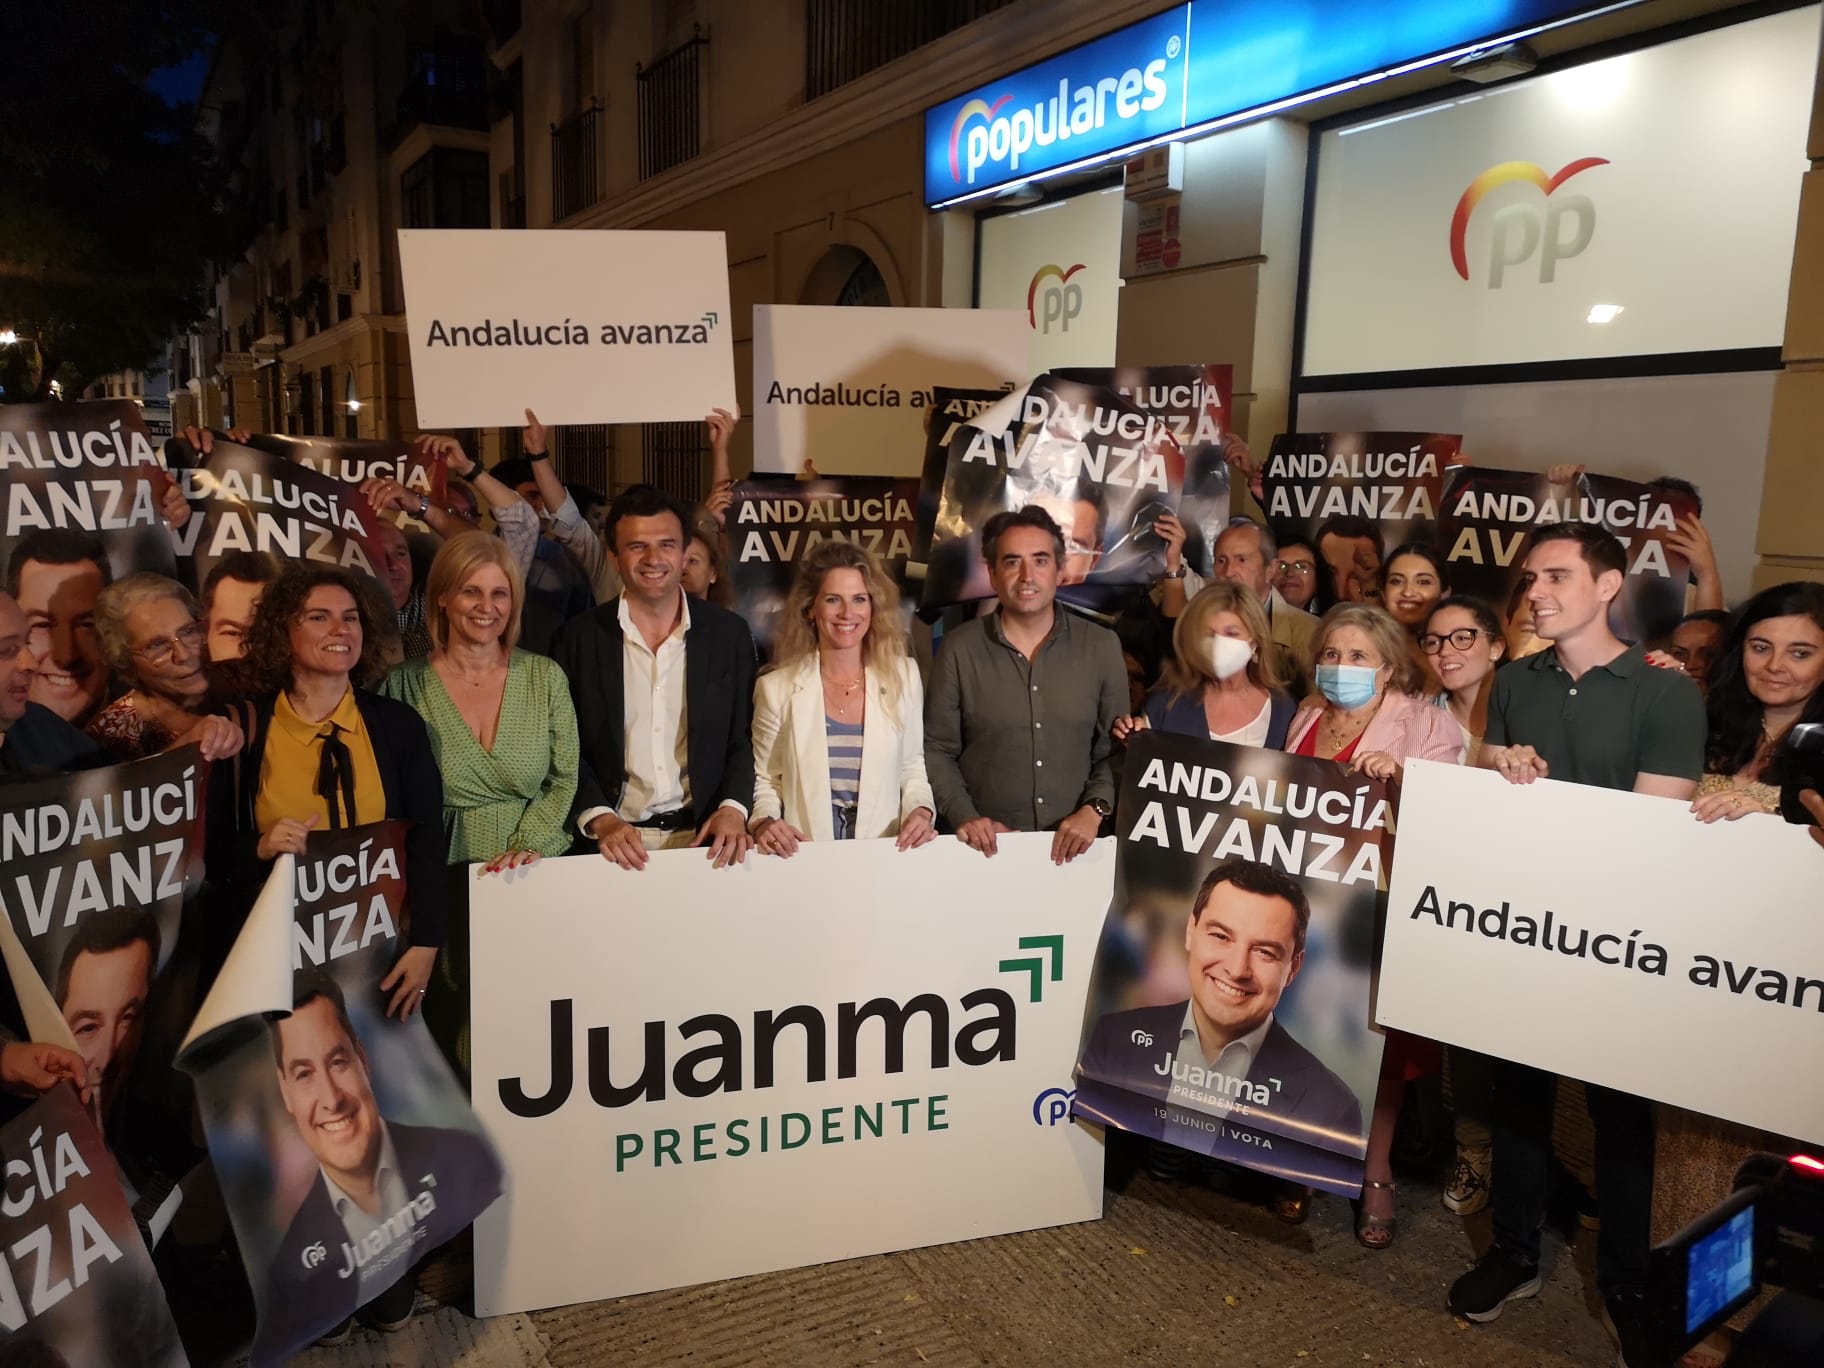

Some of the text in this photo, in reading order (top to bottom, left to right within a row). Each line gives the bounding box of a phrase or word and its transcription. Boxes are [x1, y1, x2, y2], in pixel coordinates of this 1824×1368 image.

[967, 58, 1167, 184] populares
[427, 318, 708, 347] Andalucía avanza
[766, 380, 900, 407] Andalucía
[1268, 445, 1439, 478] ANDALUCÍA
[737, 491, 914, 524] ANDALUCÍA
[1270, 485, 1436, 520] AVANZA
[1453, 490, 1677, 532] ANDALUCÍA
[1138, 758, 1397, 835] ANDALUCÍA
[1128, 801, 1389, 892] AVANZA
[294, 837, 401, 908] UCÍA
[1410, 885, 1669, 976] Andalucía
[498, 988, 1017, 1118] Juanma
[1154, 1052, 1270, 1106] Juanma
[1173, 1085, 1251, 1116] PRESIDENTE
[616, 1095, 950, 1173] PRESIDENTE
[1172, 1113, 1216, 1132] JUNIO
[1230, 1129, 1273, 1150] VOTA
